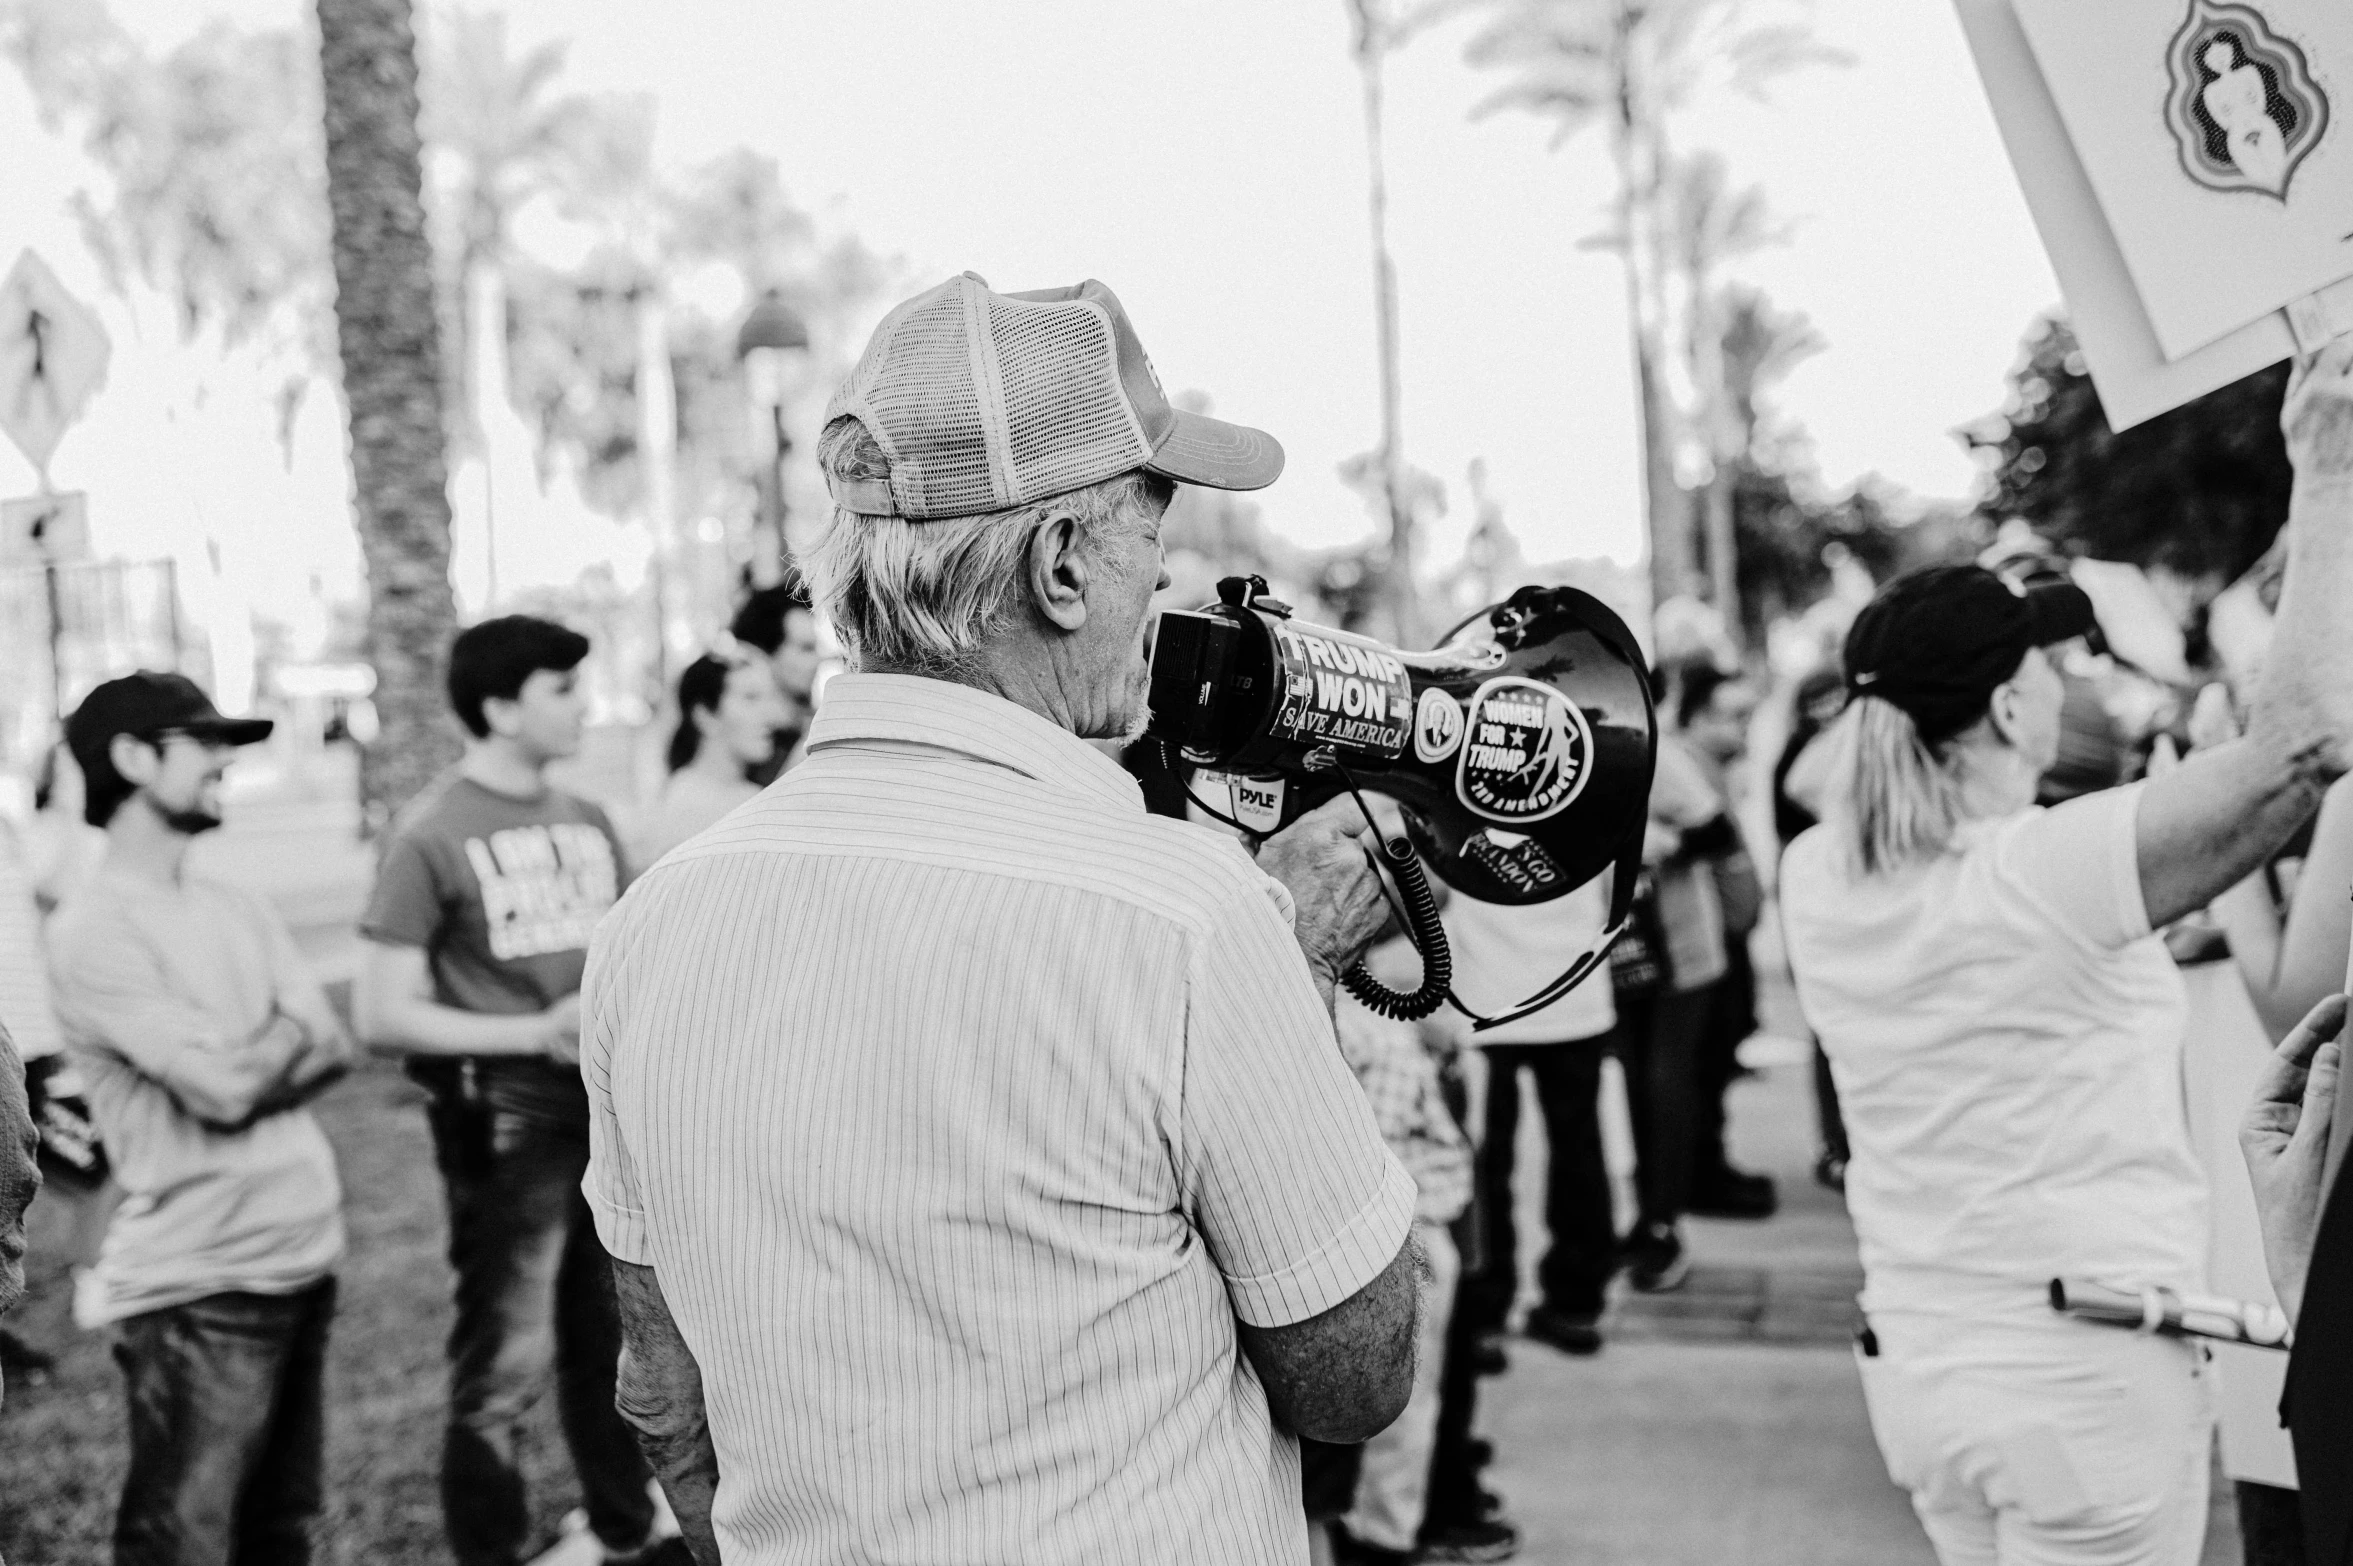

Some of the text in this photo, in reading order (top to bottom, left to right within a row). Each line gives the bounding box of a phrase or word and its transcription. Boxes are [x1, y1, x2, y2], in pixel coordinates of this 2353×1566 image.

[1274, 624, 1403, 684] TRUMP
[1315, 670, 1386, 723] WON
[1282, 707, 1331, 734] SAVE
[1329, 717, 1402, 749] AMERICA
[1483, 700, 1544, 729] WOMEN
[1479, 723, 1506, 746] FOR
[1468, 744, 1527, 773] TRUMP
[1471, 757, 1579, 812] 2ND AMENDMENT
[1527, 860, 1556, 883] GO
